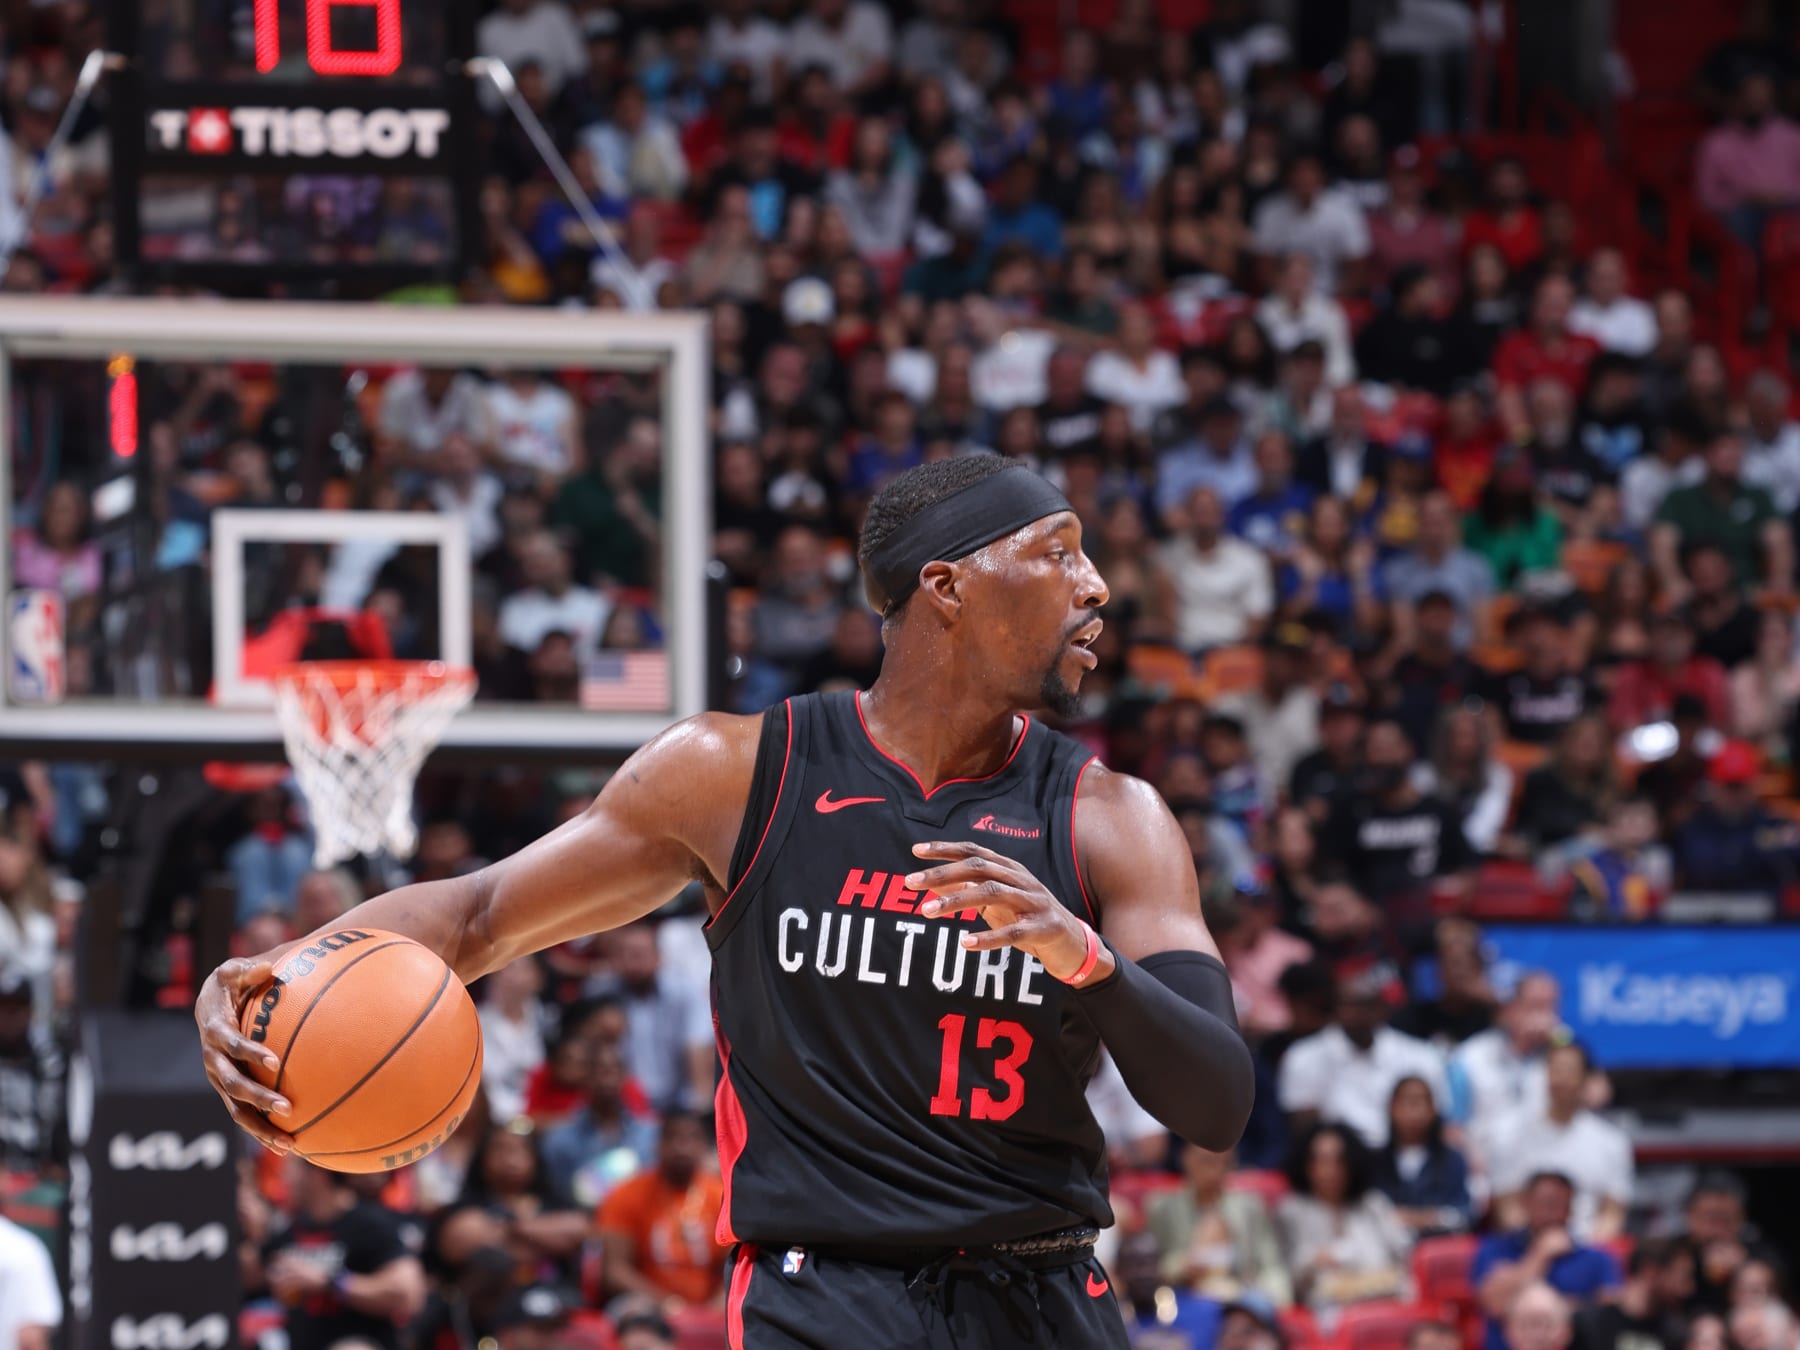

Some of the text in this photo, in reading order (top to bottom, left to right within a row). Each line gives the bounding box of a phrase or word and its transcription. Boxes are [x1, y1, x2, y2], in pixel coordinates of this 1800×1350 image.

[231, 106, 449, 157] TISSOT
[987, 822, 1040, 839] Carnival
[836, 867, 979, 922] HE
[778, 907, 1045, 1006] CULTURE
[1578, 961, 1787, 1039] Kaseya
[930, 1012, 1034, 1121] 13
